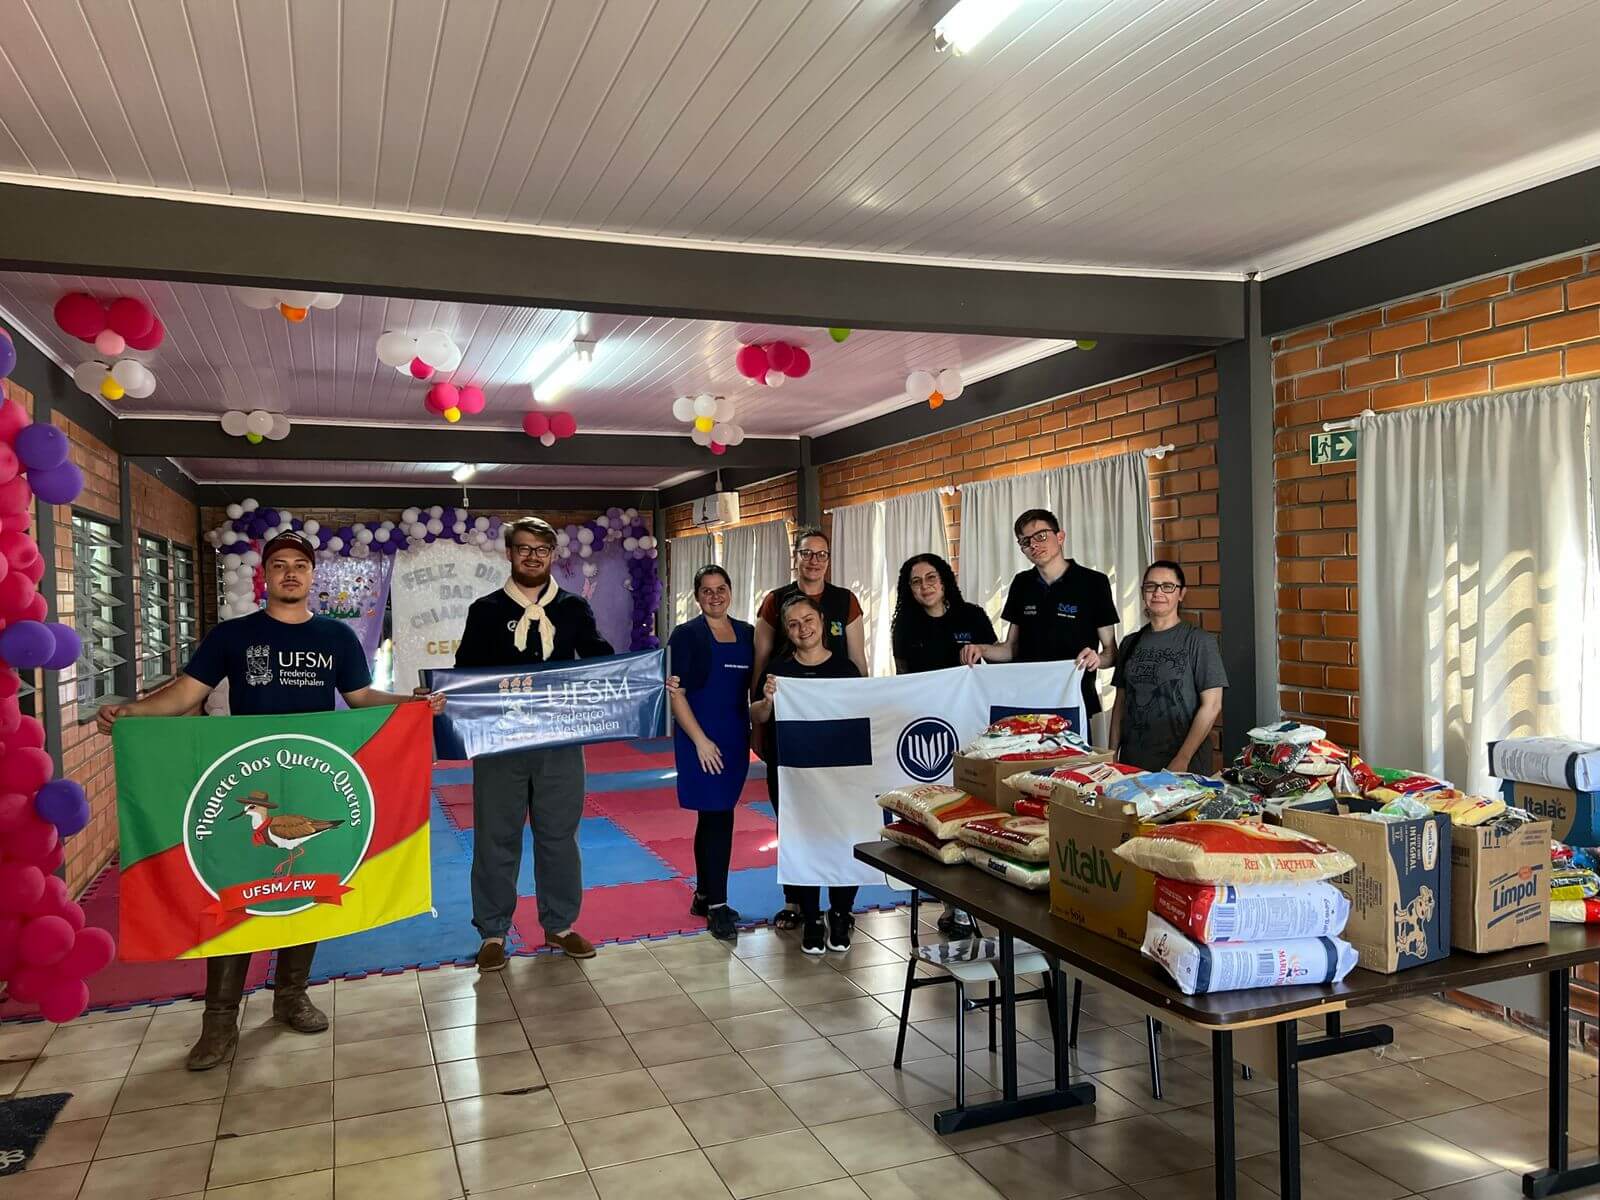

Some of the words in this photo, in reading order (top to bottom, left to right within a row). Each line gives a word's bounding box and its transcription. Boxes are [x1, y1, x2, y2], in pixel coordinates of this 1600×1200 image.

[401, 563, 457, 590] FELIZ
[439, 584, 473, 600] DAS
[278, 651, 333, 671] UFSM
[279, 669, 317, 678] Frederico
[279, 677, 325, 688] Westphalen
[546, 676, 632, 706] UFSM
[550, 708, 605, 723] Frederico
[549, 719, 620, 738] Westphalen
[195, 773, 241, 841] Piquete
[238, 756, 272, 777] dos
[276, 749, 362, 828] Quero-Queros
[1409, 826, 1417, 871] INTEGRAL
[242, 879, 316, 899] UFSM/FW
[1493, 874, 1537, 912] Limpol
